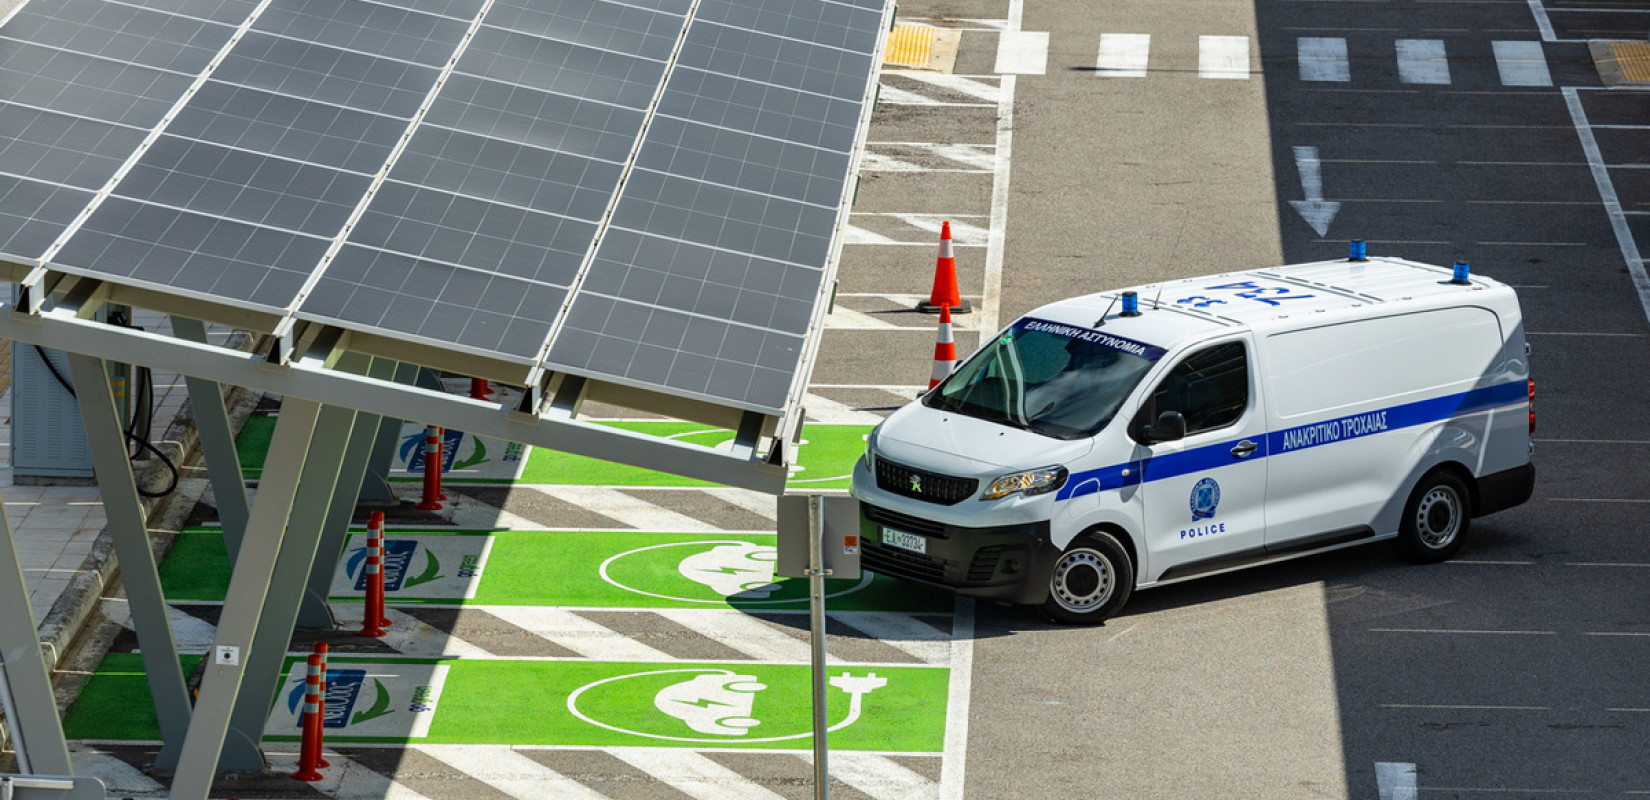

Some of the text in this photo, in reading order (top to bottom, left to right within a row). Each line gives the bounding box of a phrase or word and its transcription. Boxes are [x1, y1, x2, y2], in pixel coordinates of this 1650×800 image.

[1024, 321, 1146, 356] ΕΛΛΗΝΙΚΗ ΑΣΤΥΝΟΜΙΑ
[1283, 411, 1388, 451] ΑΝΑΚΡΙΤΙΚΟ ΤΡΟΧΑΙΑΣ
[1180, 523, 1226, 540] POLICE
